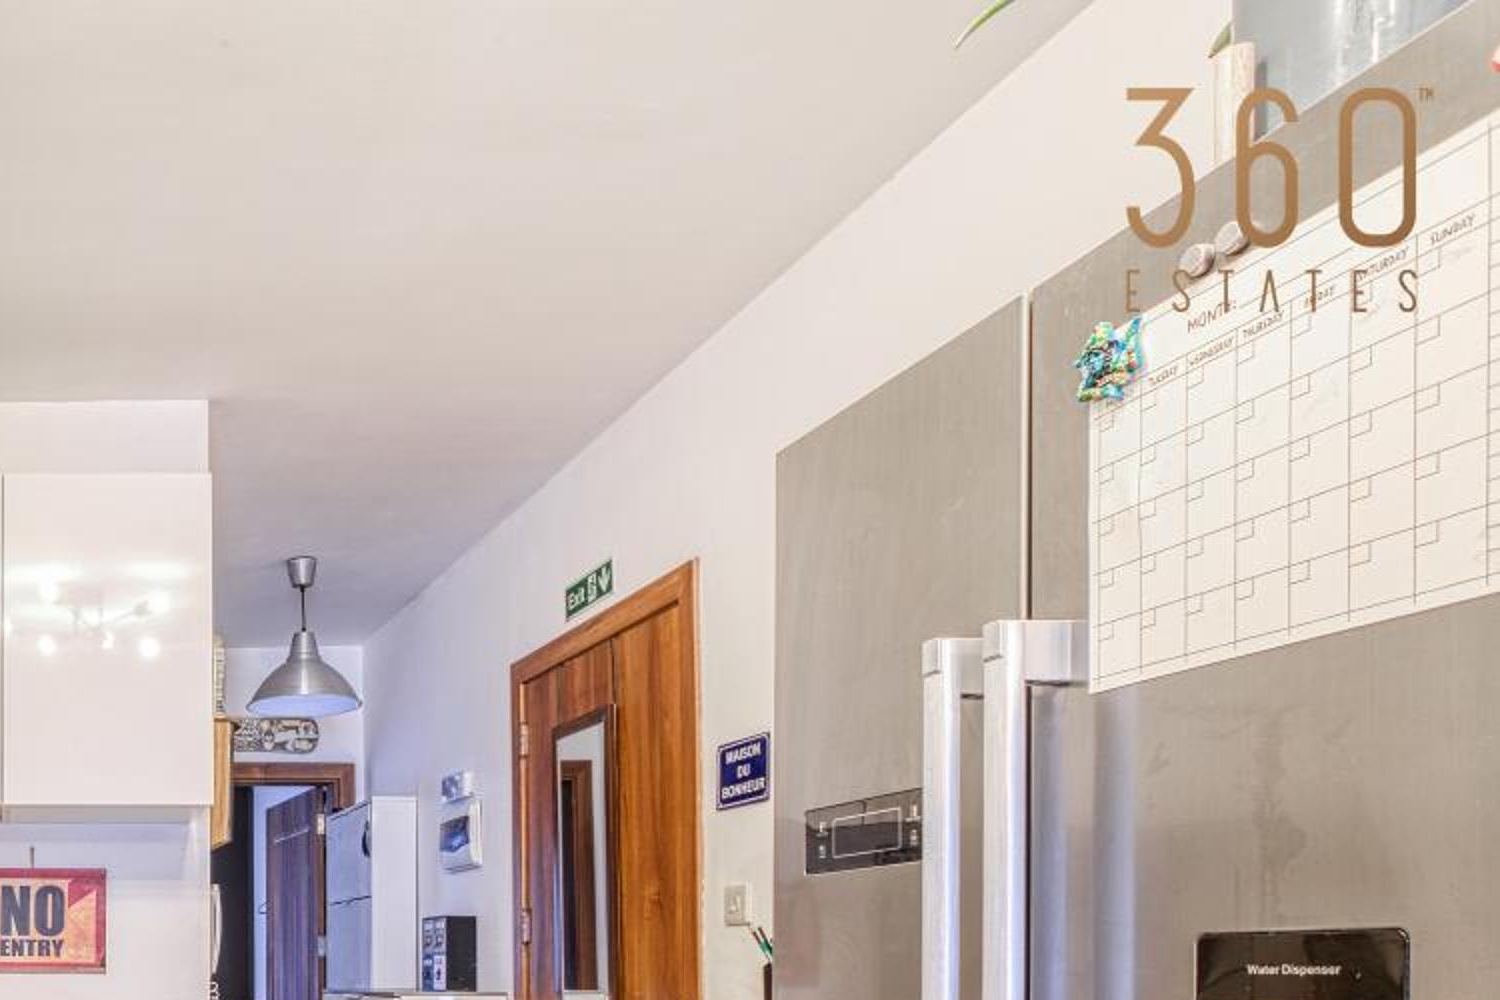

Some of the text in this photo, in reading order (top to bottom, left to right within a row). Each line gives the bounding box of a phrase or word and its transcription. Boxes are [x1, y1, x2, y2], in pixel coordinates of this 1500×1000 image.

[725, 741, 762, 765] MAISON
[737, 763, 751, 779] DU
[721, 777, 765, 799] BONHEUR
[1, 885, 65, 937] NO
[0, 938, 64, 957] ENTRY
[1246, 963, 1341, 977] Water Dispenser
